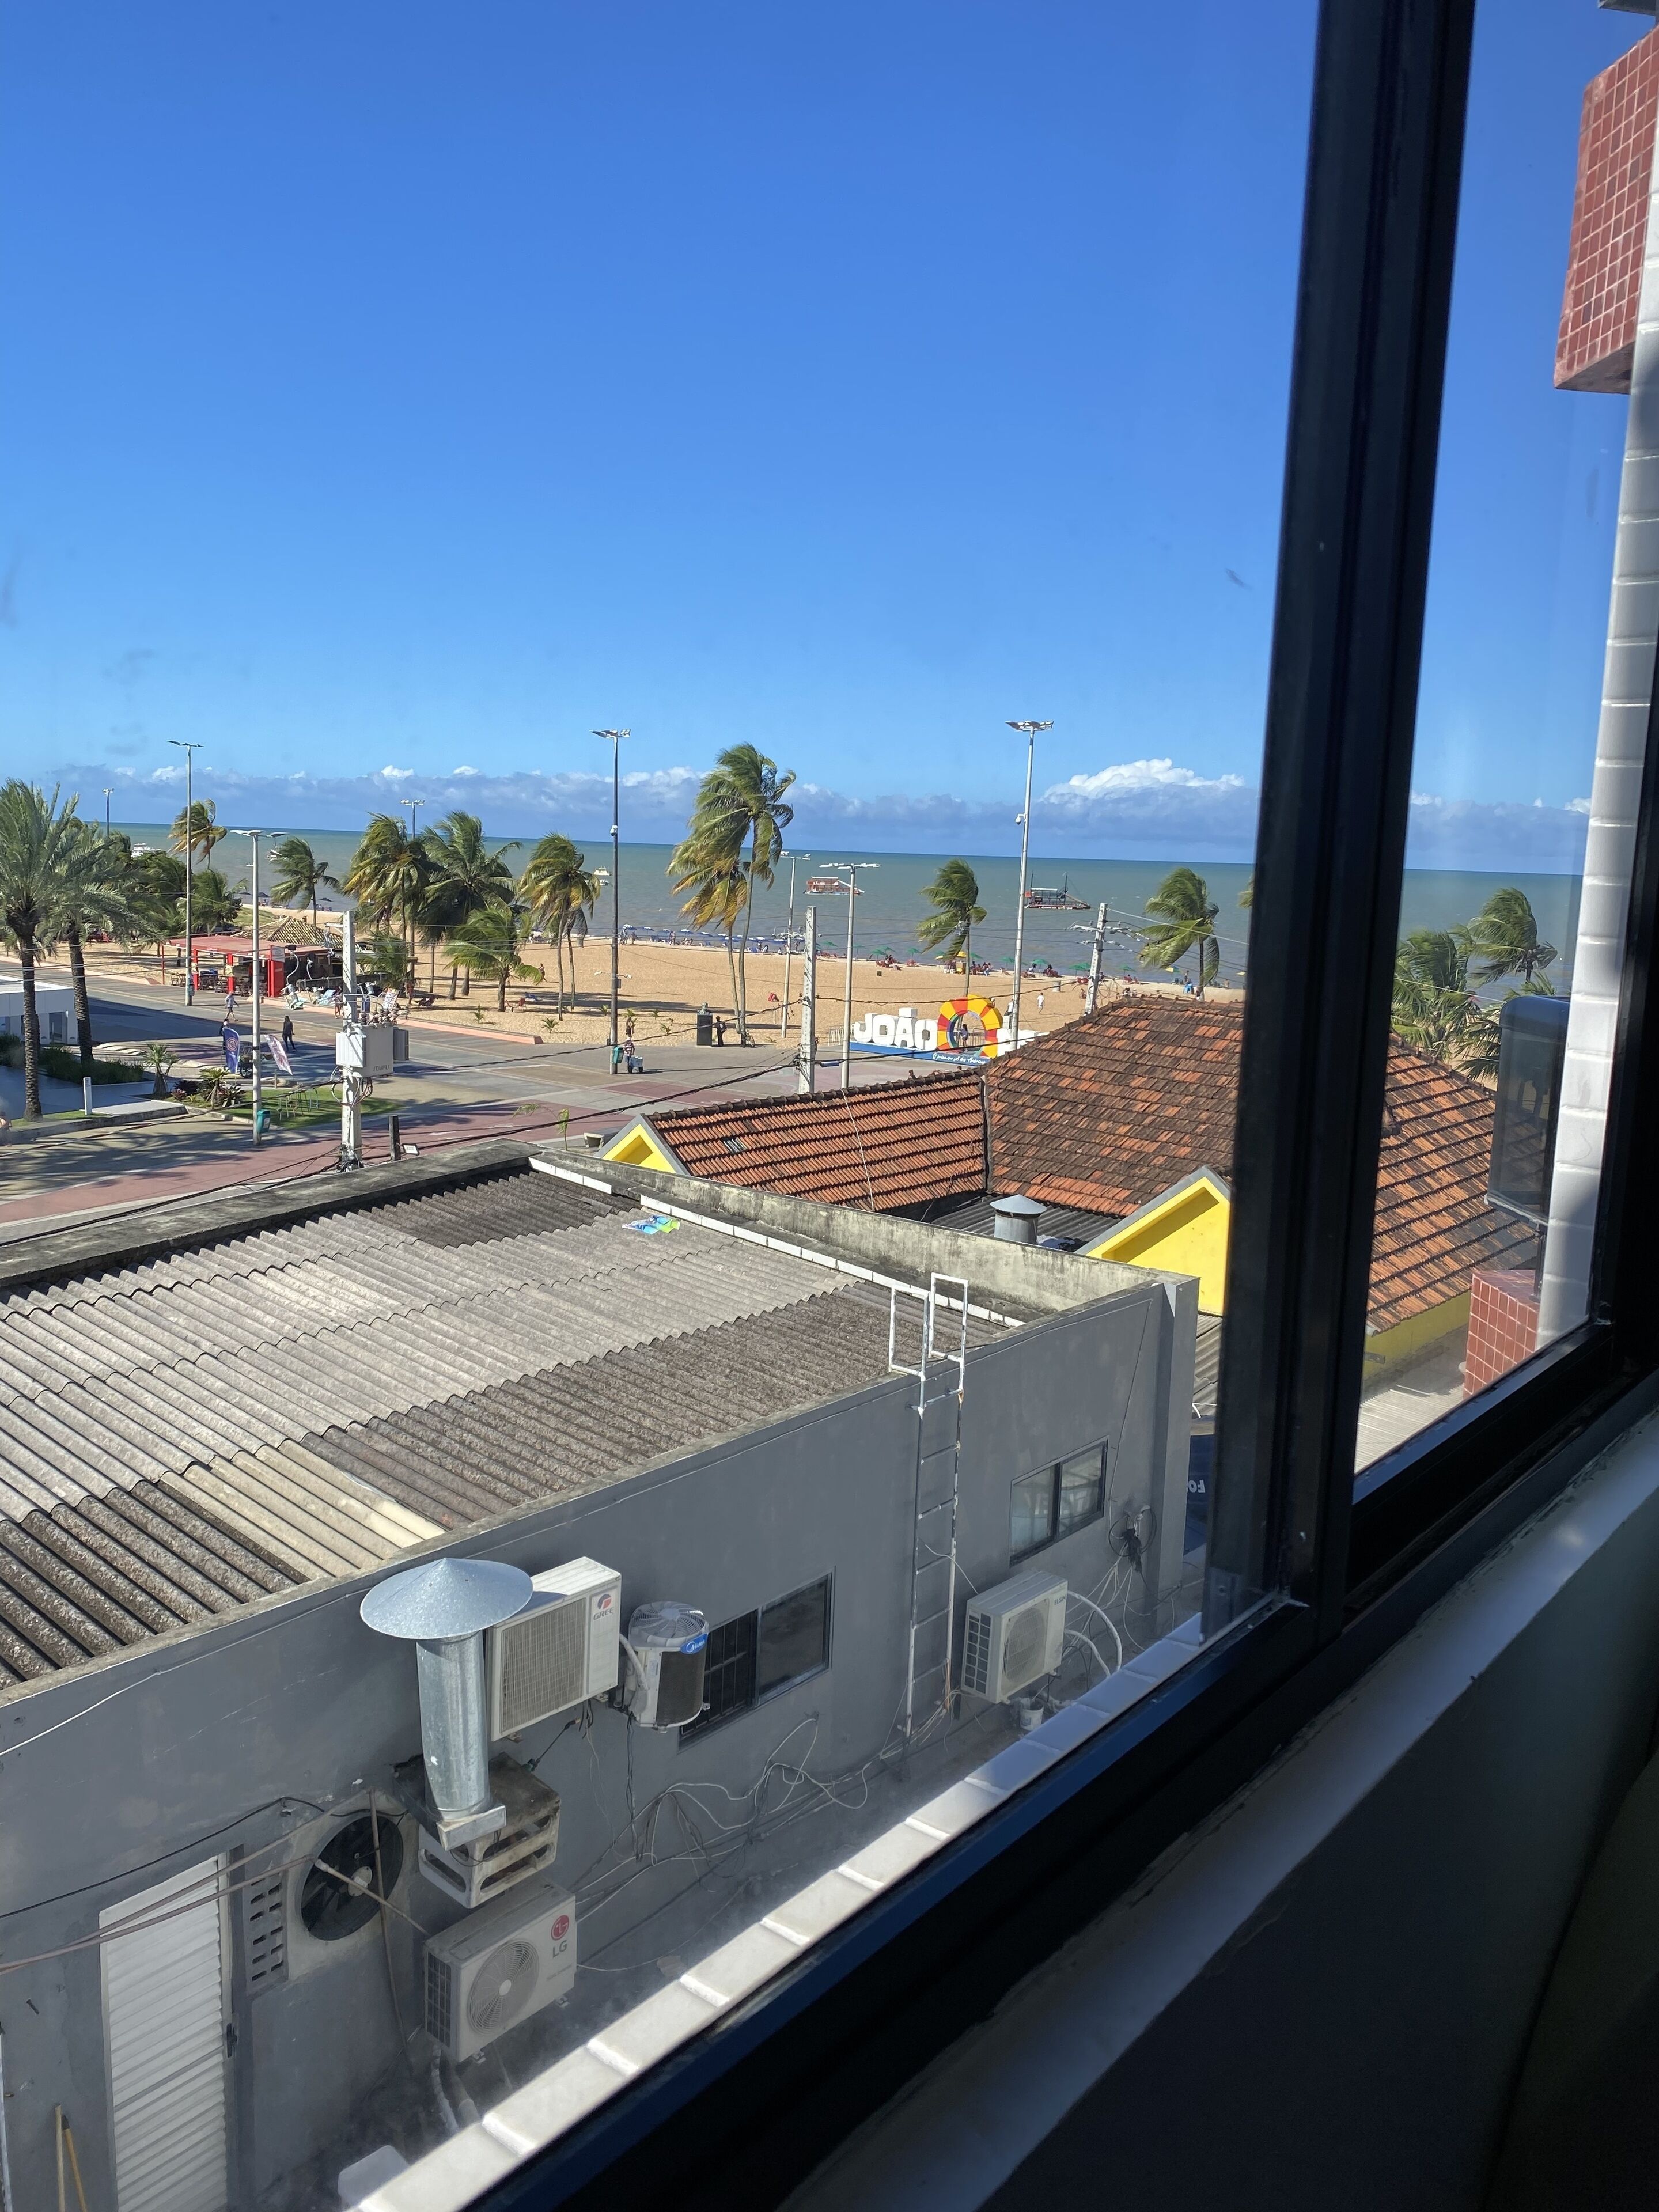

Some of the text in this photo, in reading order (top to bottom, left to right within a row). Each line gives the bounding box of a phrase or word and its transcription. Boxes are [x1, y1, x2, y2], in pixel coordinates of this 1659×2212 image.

[854, 1007, 938, 1051] JOÃO
[373, 1064, 389, 1072] ITAIPU
[593, 1607, 614, 1620] GREE
[552, 1940, 567, 1958] LG
